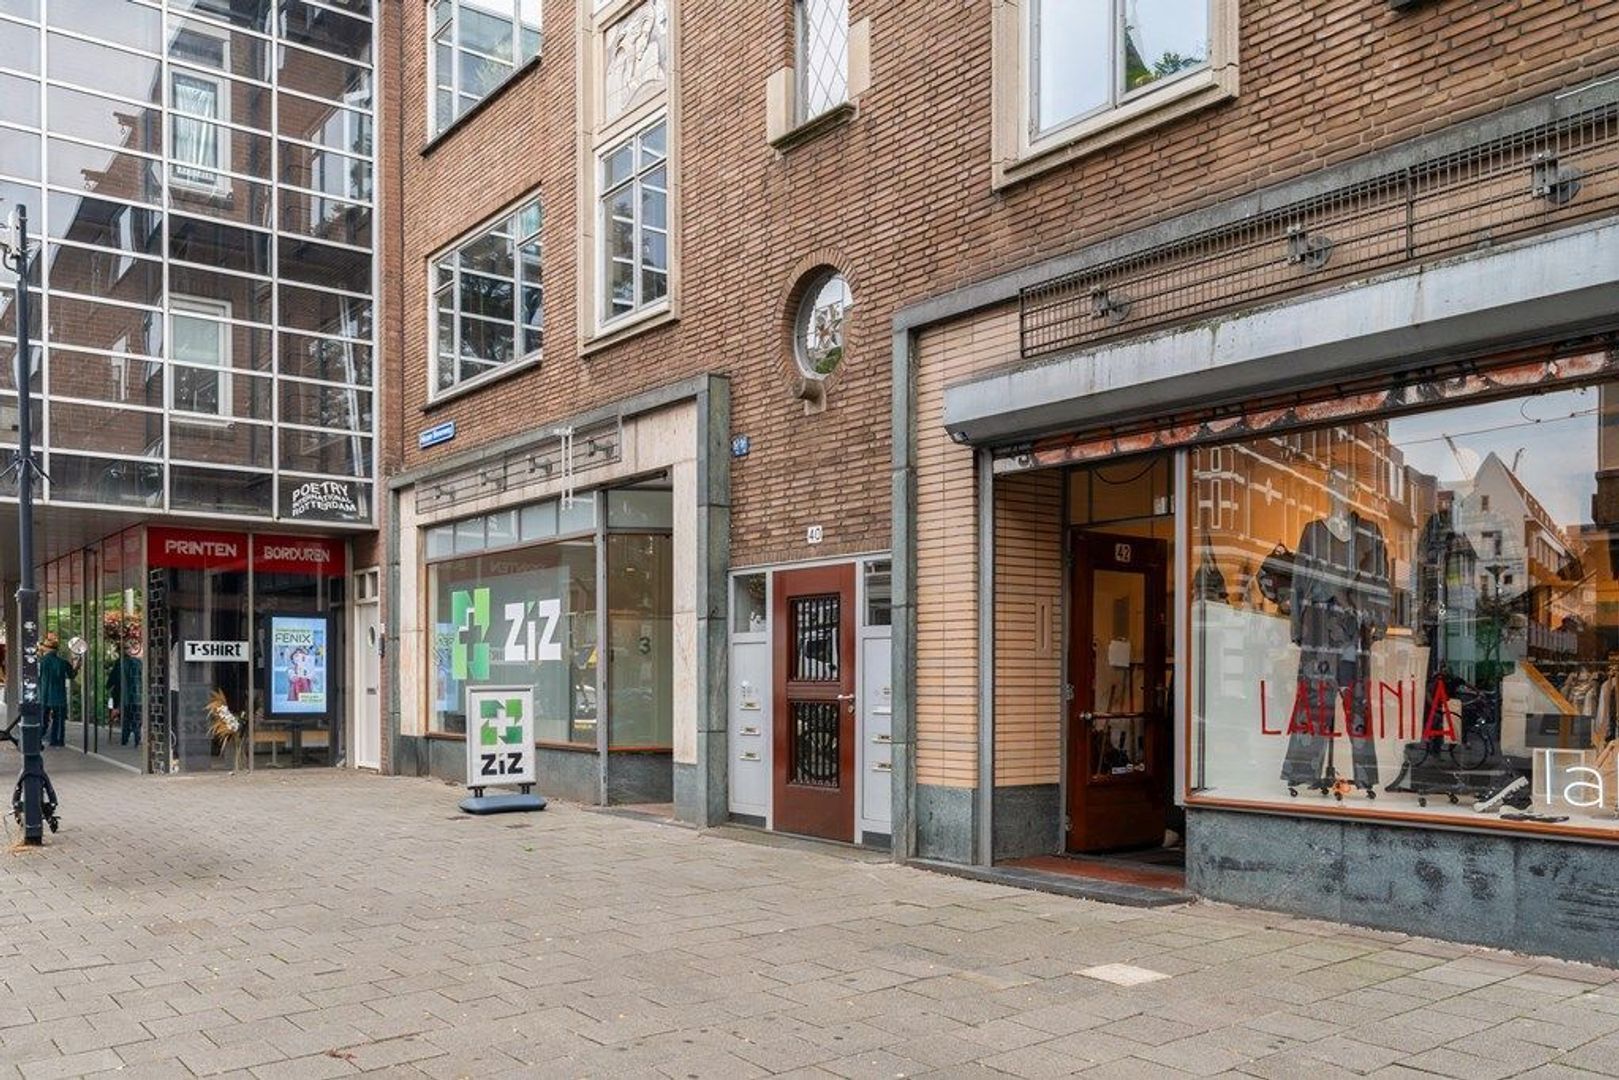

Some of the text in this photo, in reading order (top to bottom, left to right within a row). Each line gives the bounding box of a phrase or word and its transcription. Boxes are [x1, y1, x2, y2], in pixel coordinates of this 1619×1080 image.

[292, 481, 348, 502] POETRY
[292, 501, 357, 517] ROTTERDAM
[809, 527, 822, 541] 40
[165, 539, 238, 558] PRINTEN
[264, 545, 331, 563] BORDUREN
[1117, 544, 1130, 561] 42
[274, 633, 312, 644] FENIX
